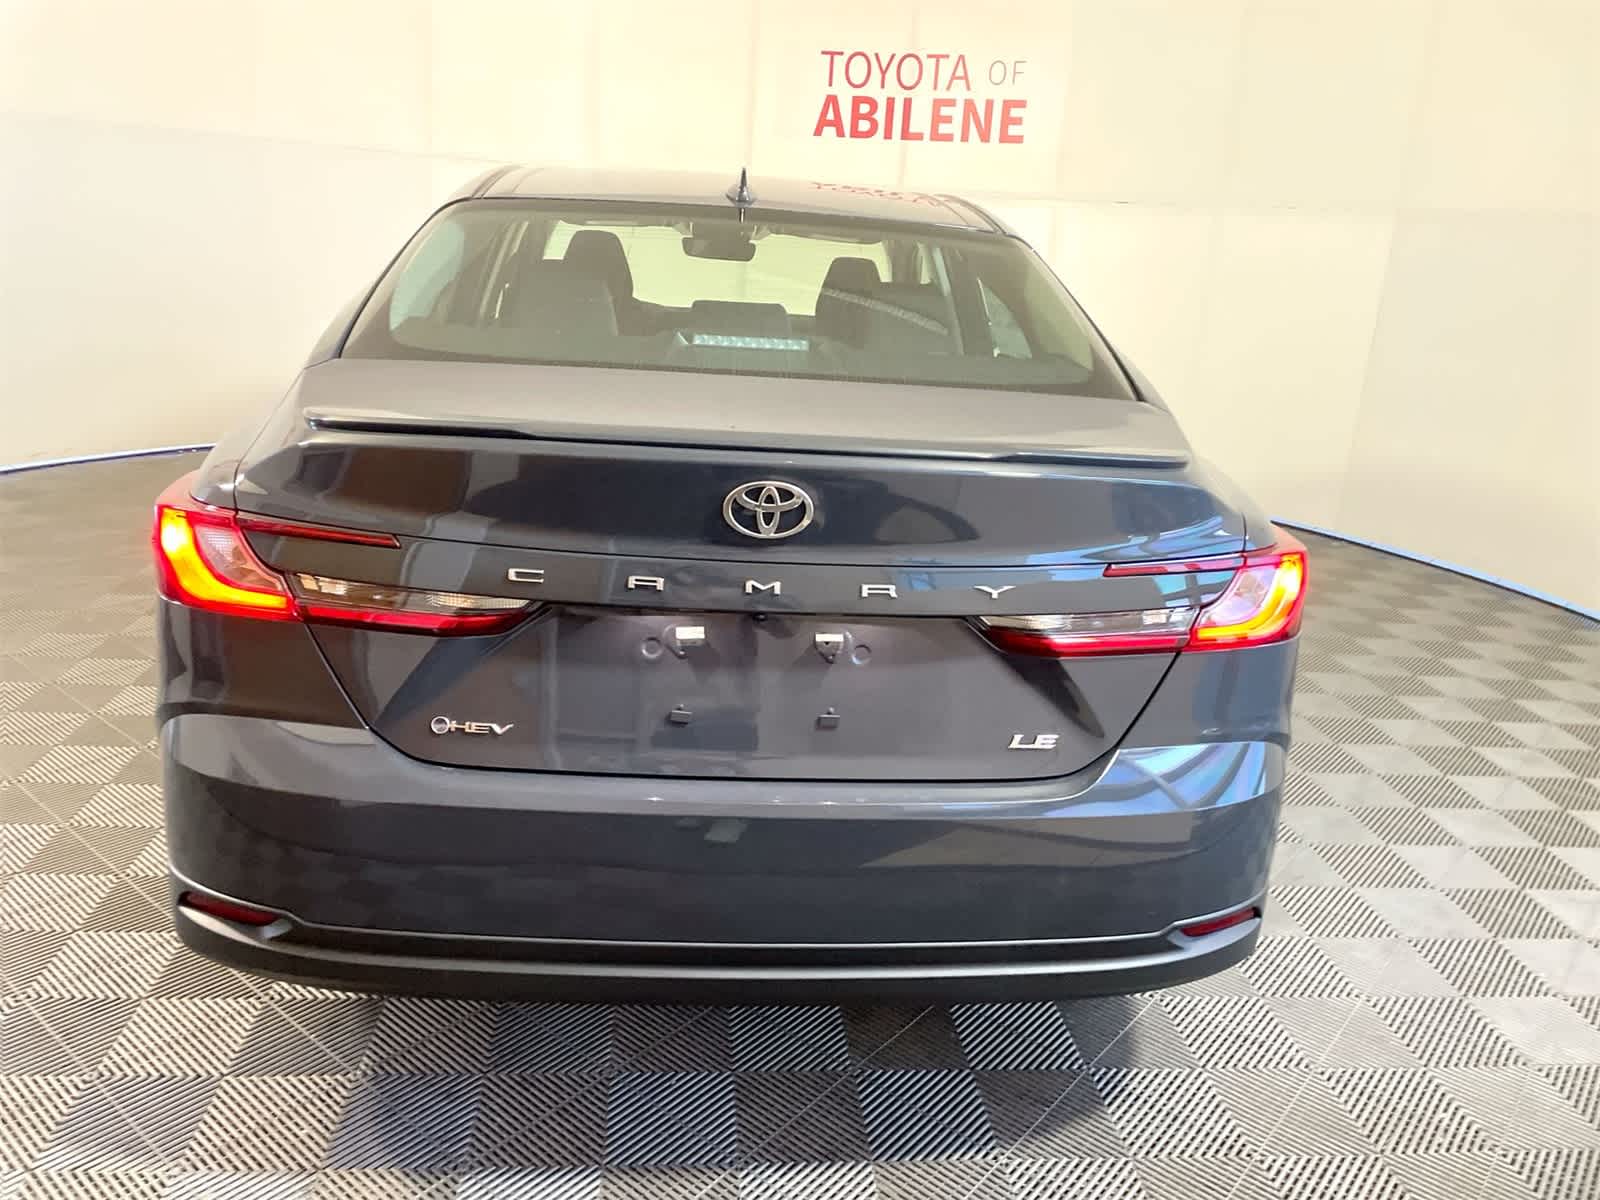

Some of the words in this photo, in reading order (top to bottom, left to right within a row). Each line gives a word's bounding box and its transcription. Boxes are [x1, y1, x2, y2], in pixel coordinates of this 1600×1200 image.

[821, 50, 972, 92] TOYOTA
[988, 60, 1028, 86] OF
[813, 94, 1028, 144] ABILENE
[507, 567, 1016, 599] CAMRY
[1008, 734, 1060, 750] LE
